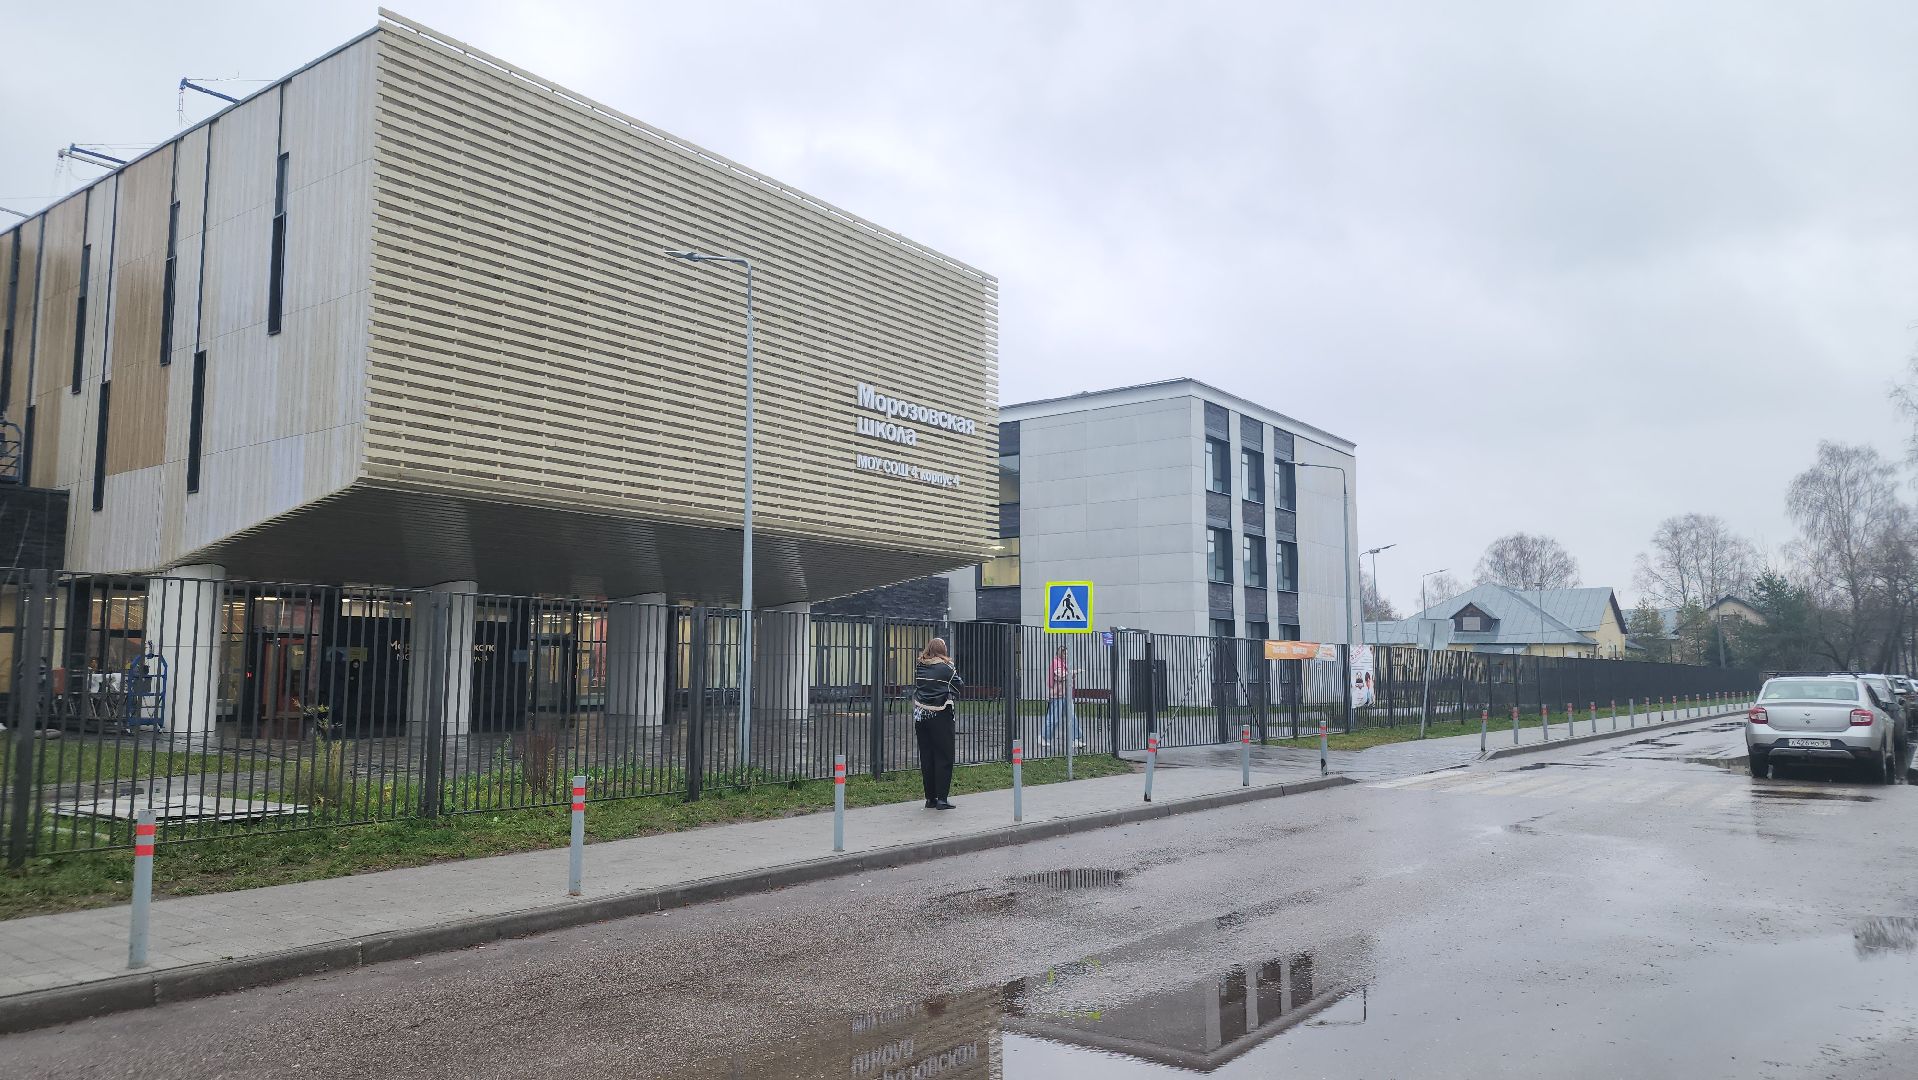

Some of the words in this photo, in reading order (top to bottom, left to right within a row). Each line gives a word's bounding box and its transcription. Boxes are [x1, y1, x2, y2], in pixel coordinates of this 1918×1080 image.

[857, 382, 975, 435] Морозовская
[856, 416, 917, 446] школа
[856, 454, 882, 470] МОУ
[882, 460, 909, 477] СОШ
[920, 470, 952, 486] корпус
